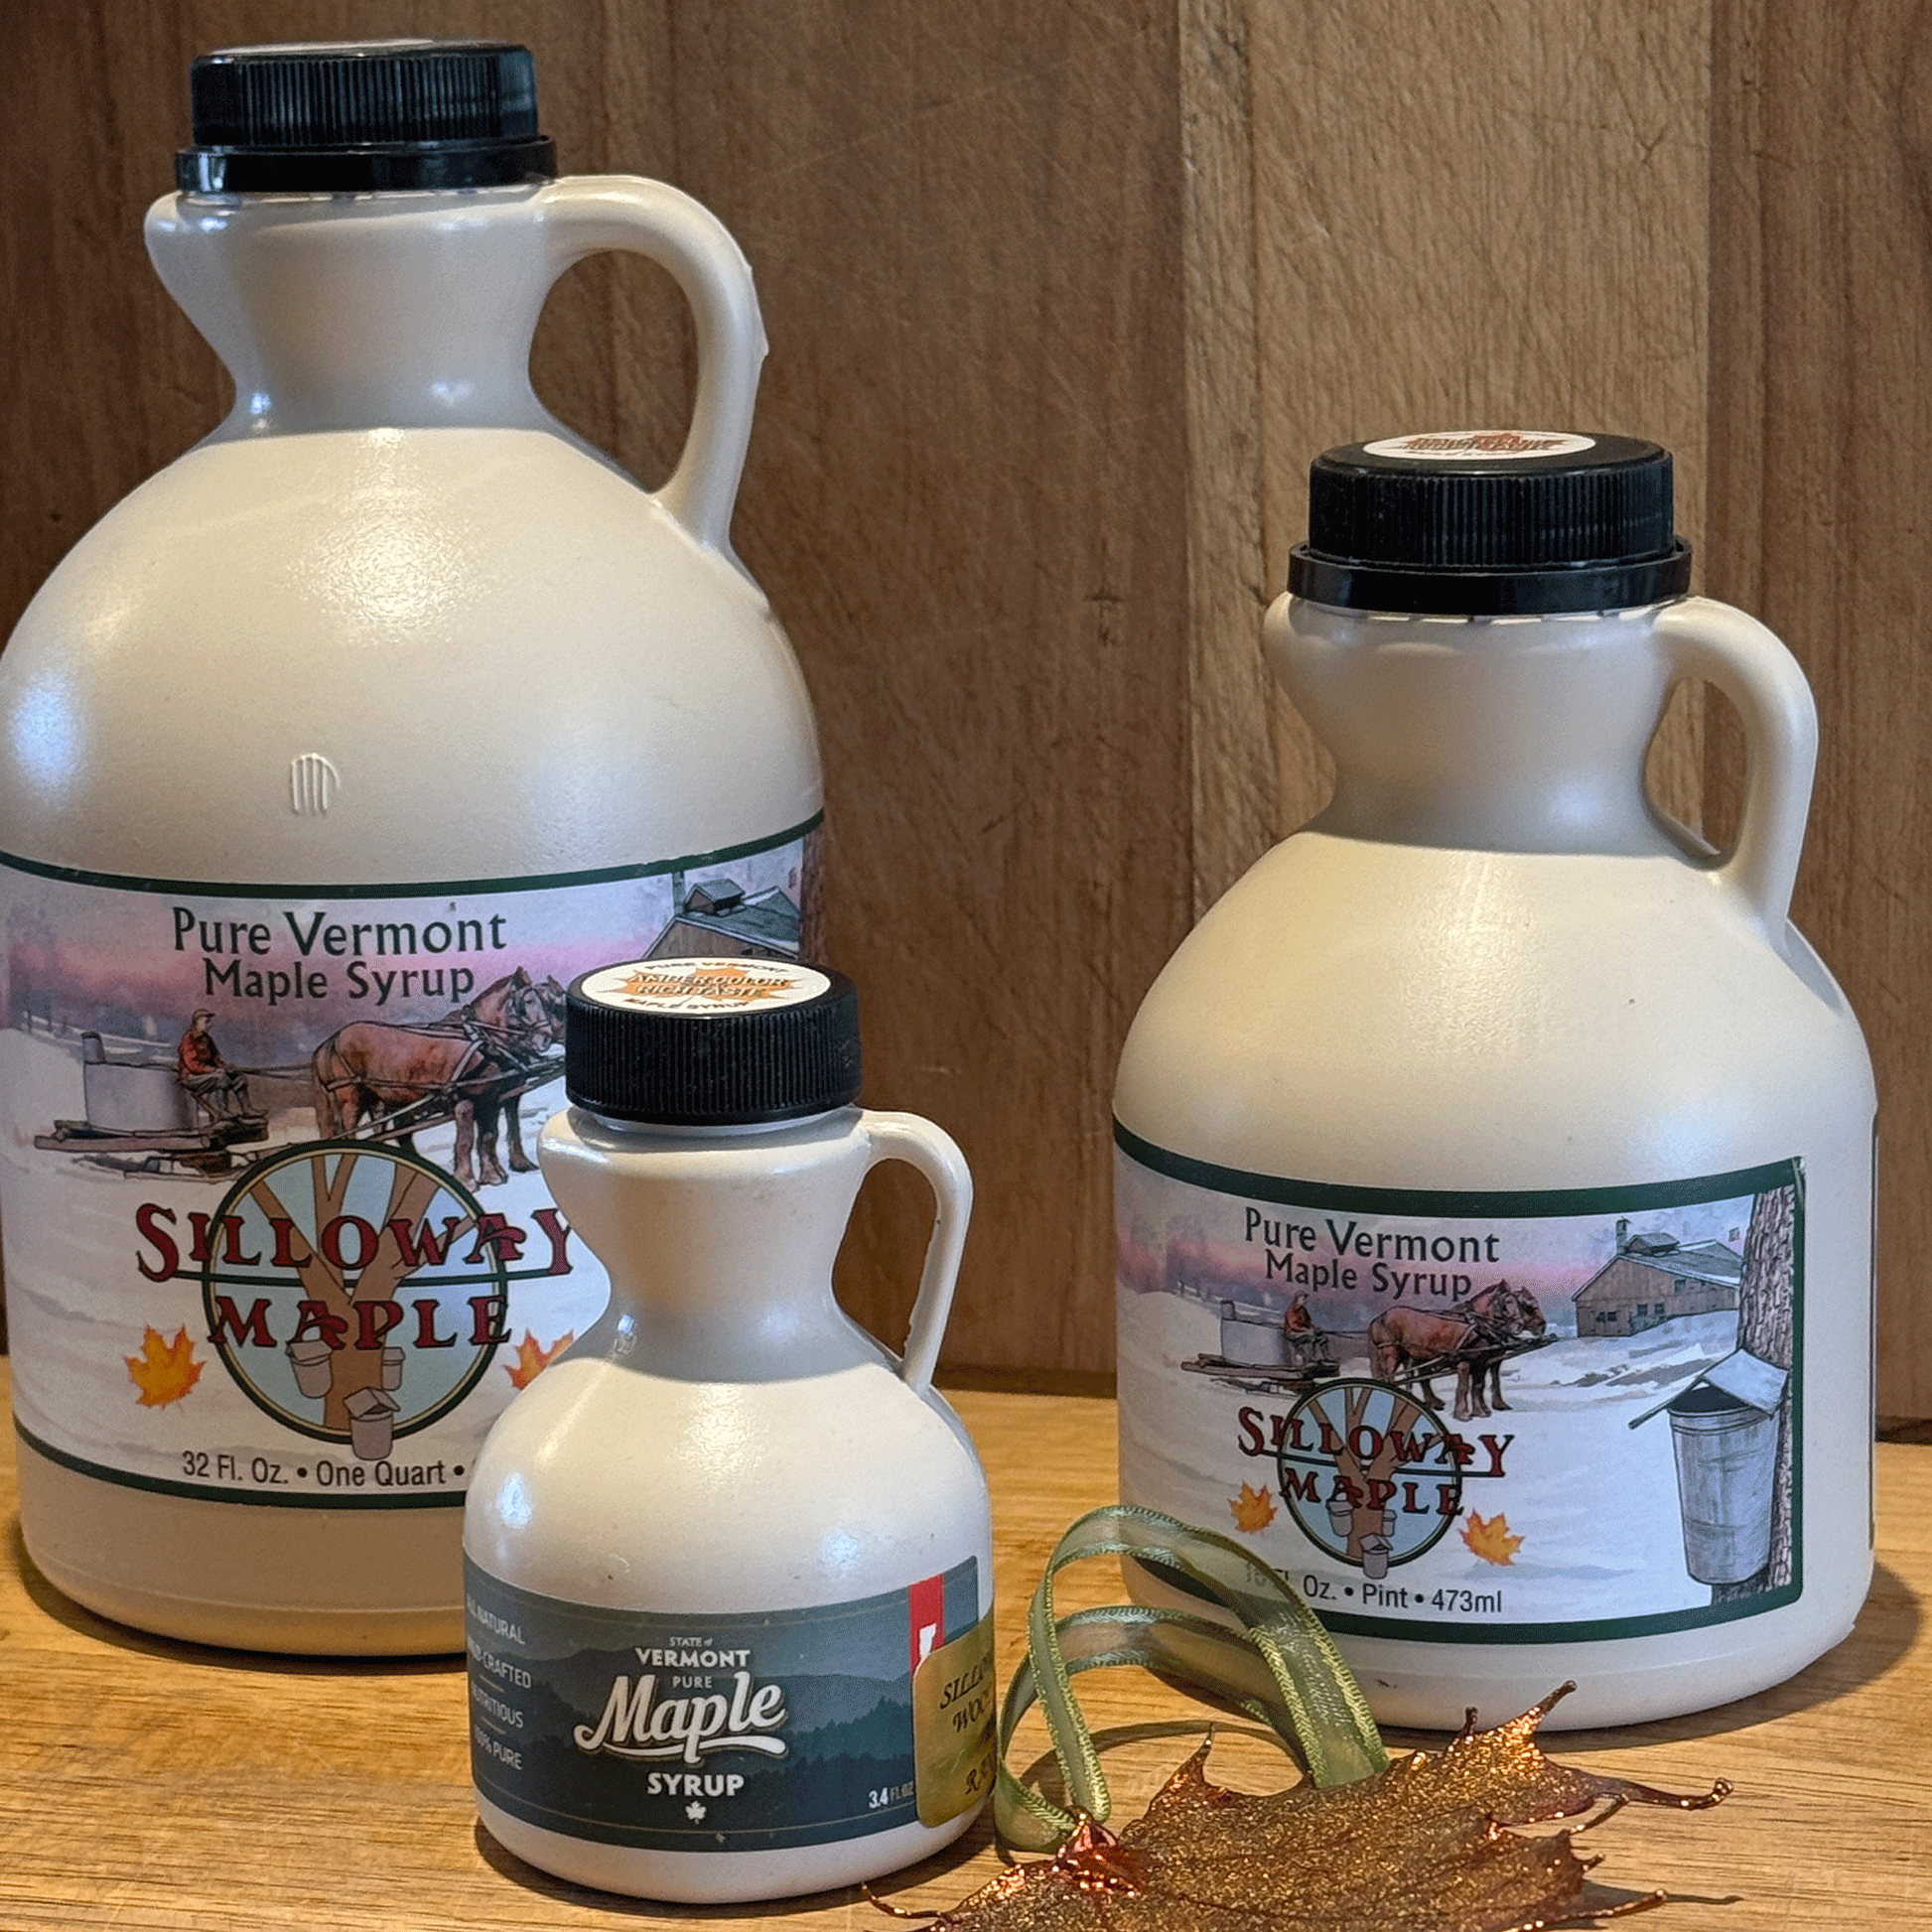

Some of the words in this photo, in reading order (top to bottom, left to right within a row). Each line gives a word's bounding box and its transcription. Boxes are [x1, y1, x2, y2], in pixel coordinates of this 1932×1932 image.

[173, 906, 271, 954] Pure
[283, 911, 507, 956] Vermont
[204, 958, 328, 1007] Maple
[346, 963, 475, 1006] Syrup
[136, 1203, 572, 1282] SILLOWAY
[1245, 1207, 1315, 1251] Pure
[1326, 1219, 1500, 1263] Vermont
[1266, 1249, 1357, 1292] Maple
[1372, 1262, 1471, 1302] Syrup
[207, 1296, 511, 1350] MAPLE
[1238, 1407, 1515, 1477] SILLOWAY
[182, 1450, 208, 1477] 32
[217, 1453, 242, 1482] Fl.
[250, 1456, 289, 1483] Oz.
[316, 1461, 365, 1486] One
[374, 1459, 446, 1488] Quart
[1279, 1467, 1463, 1516] MAPLE
[1303, 1576, 1336, 1600] Oz.
[1362, 1583, 1408, 1609] Pint
[1432, 1588, 1502, 1613] 473ml
[634, 1647, 752, 1668] VERMONT
[669, 1636, 703, 1648] STATE
[672, 1675, 713, 1688] PURE
[573, 1670, 787, 1765] Maple
[492, 1741, 523, 1771] PURE
[647, 1771, 745, 1797] SYRUP
